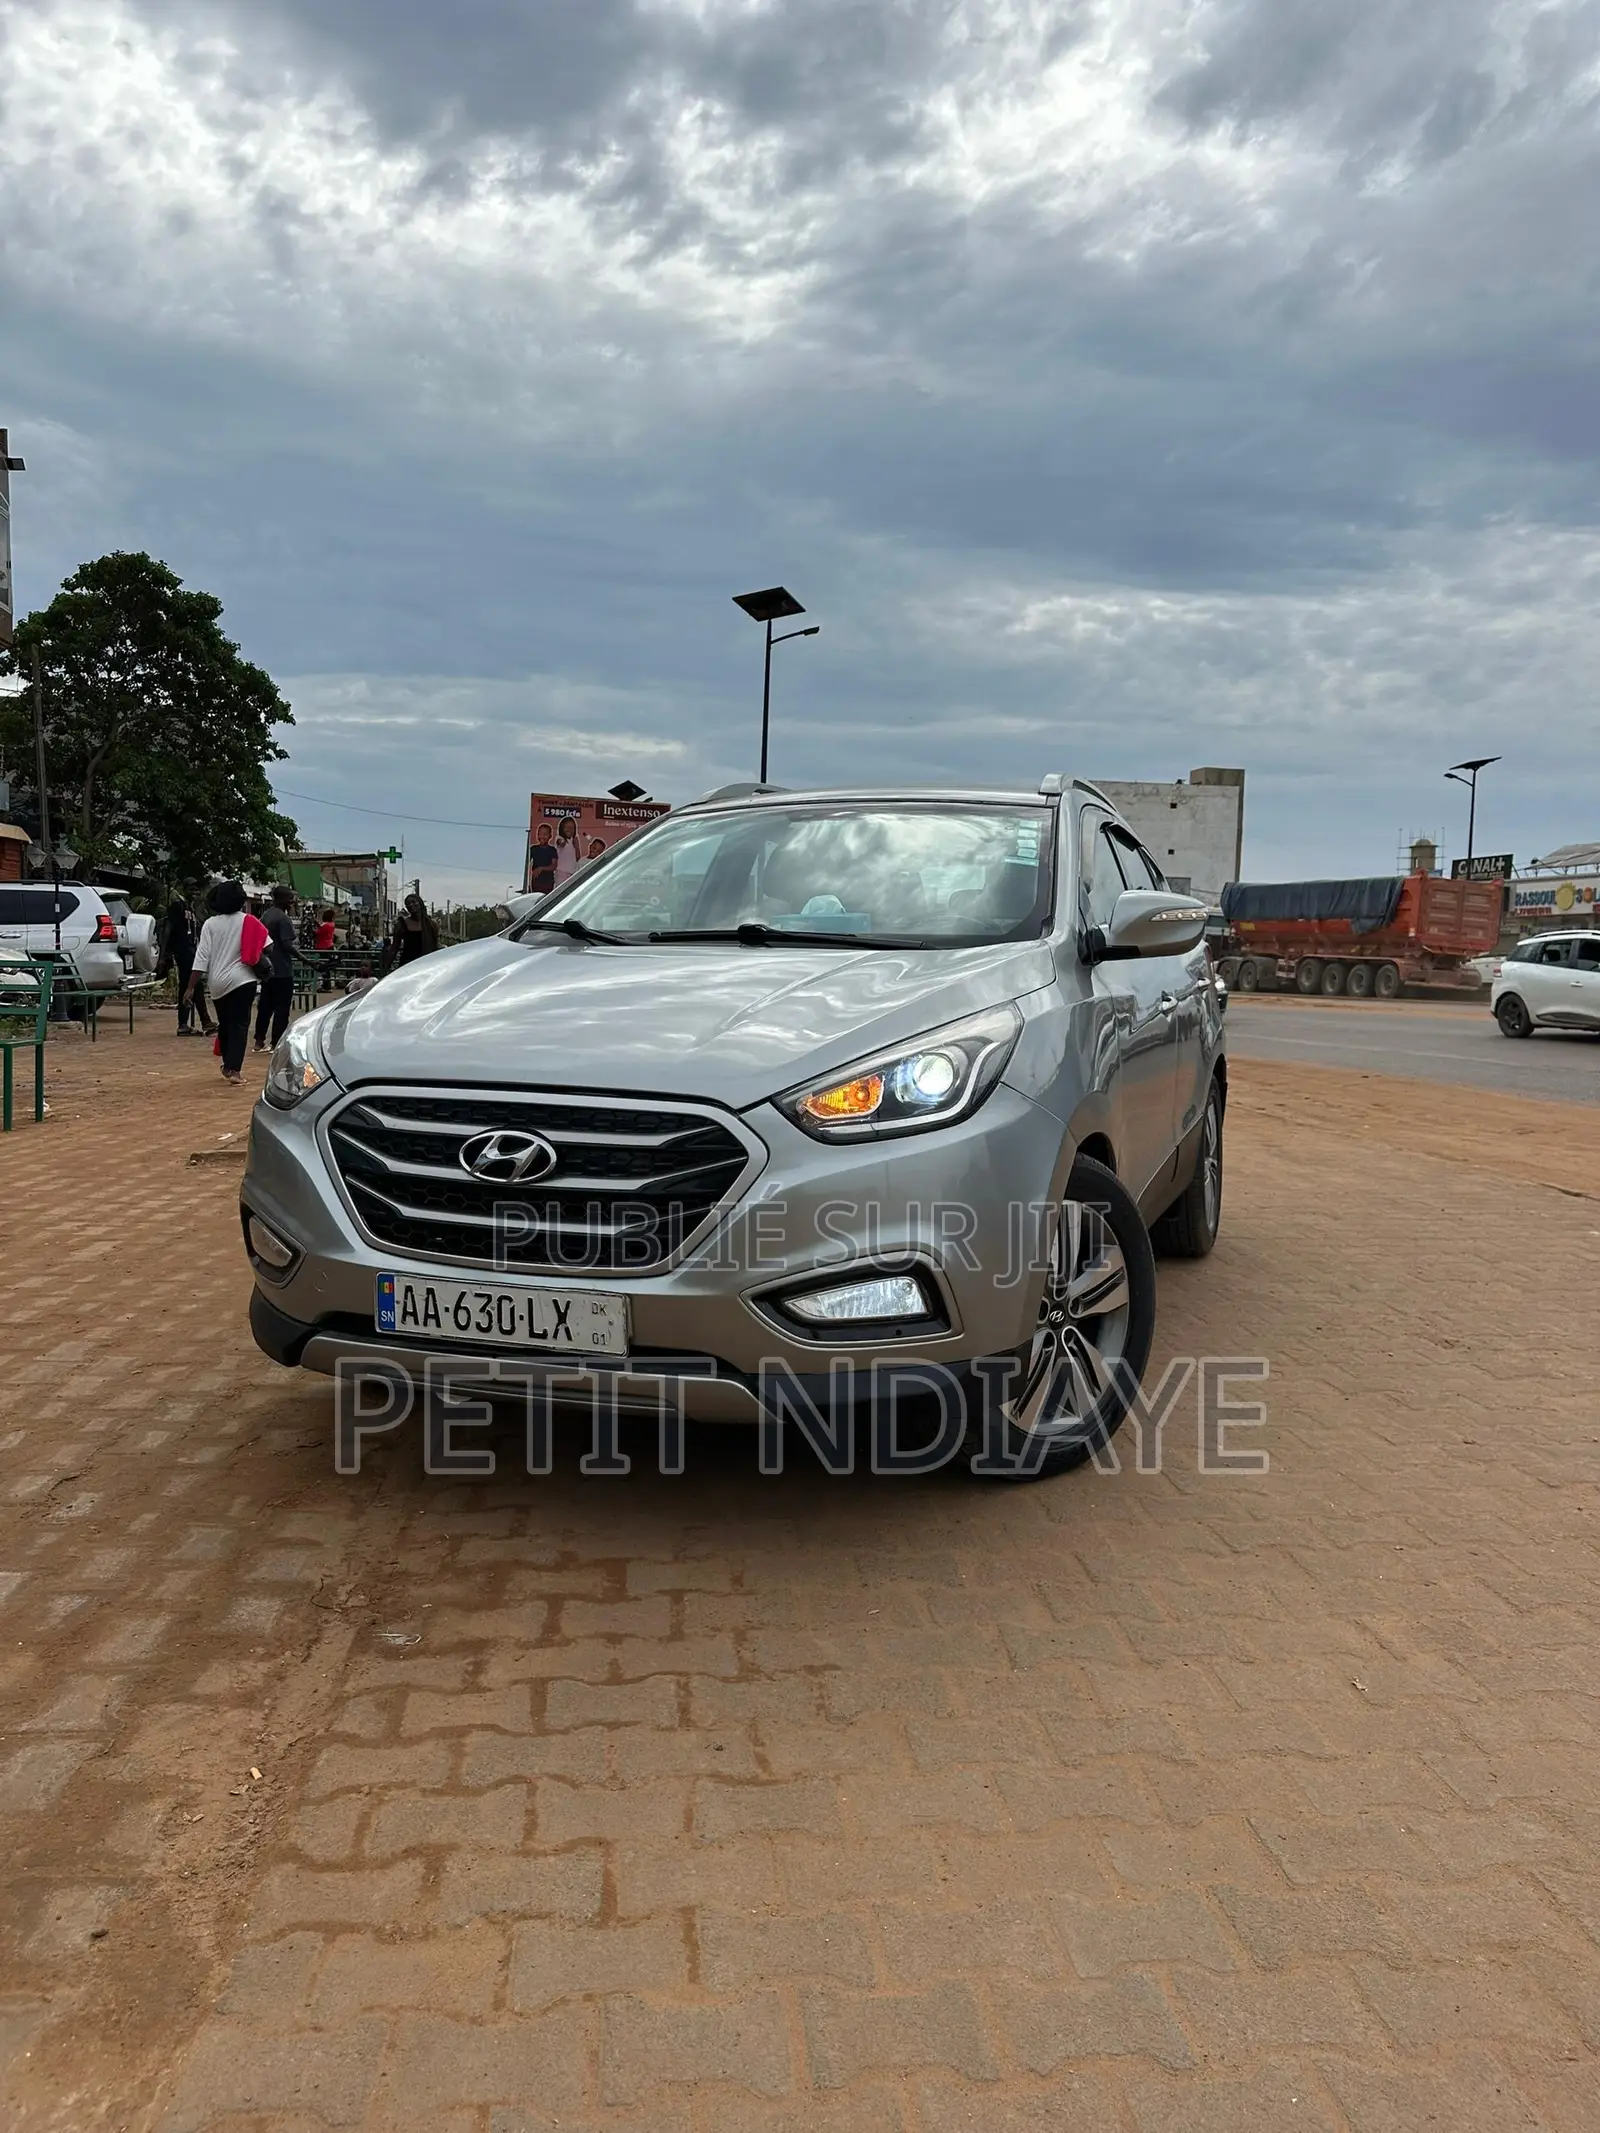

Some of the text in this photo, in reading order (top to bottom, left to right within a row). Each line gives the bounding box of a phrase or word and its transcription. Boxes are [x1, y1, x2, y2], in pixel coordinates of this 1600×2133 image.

[603, 803, 661, 818] Inextenso
[592, 1302, 607, 1316] DK
[380, 1310, 395, 1323] SN
